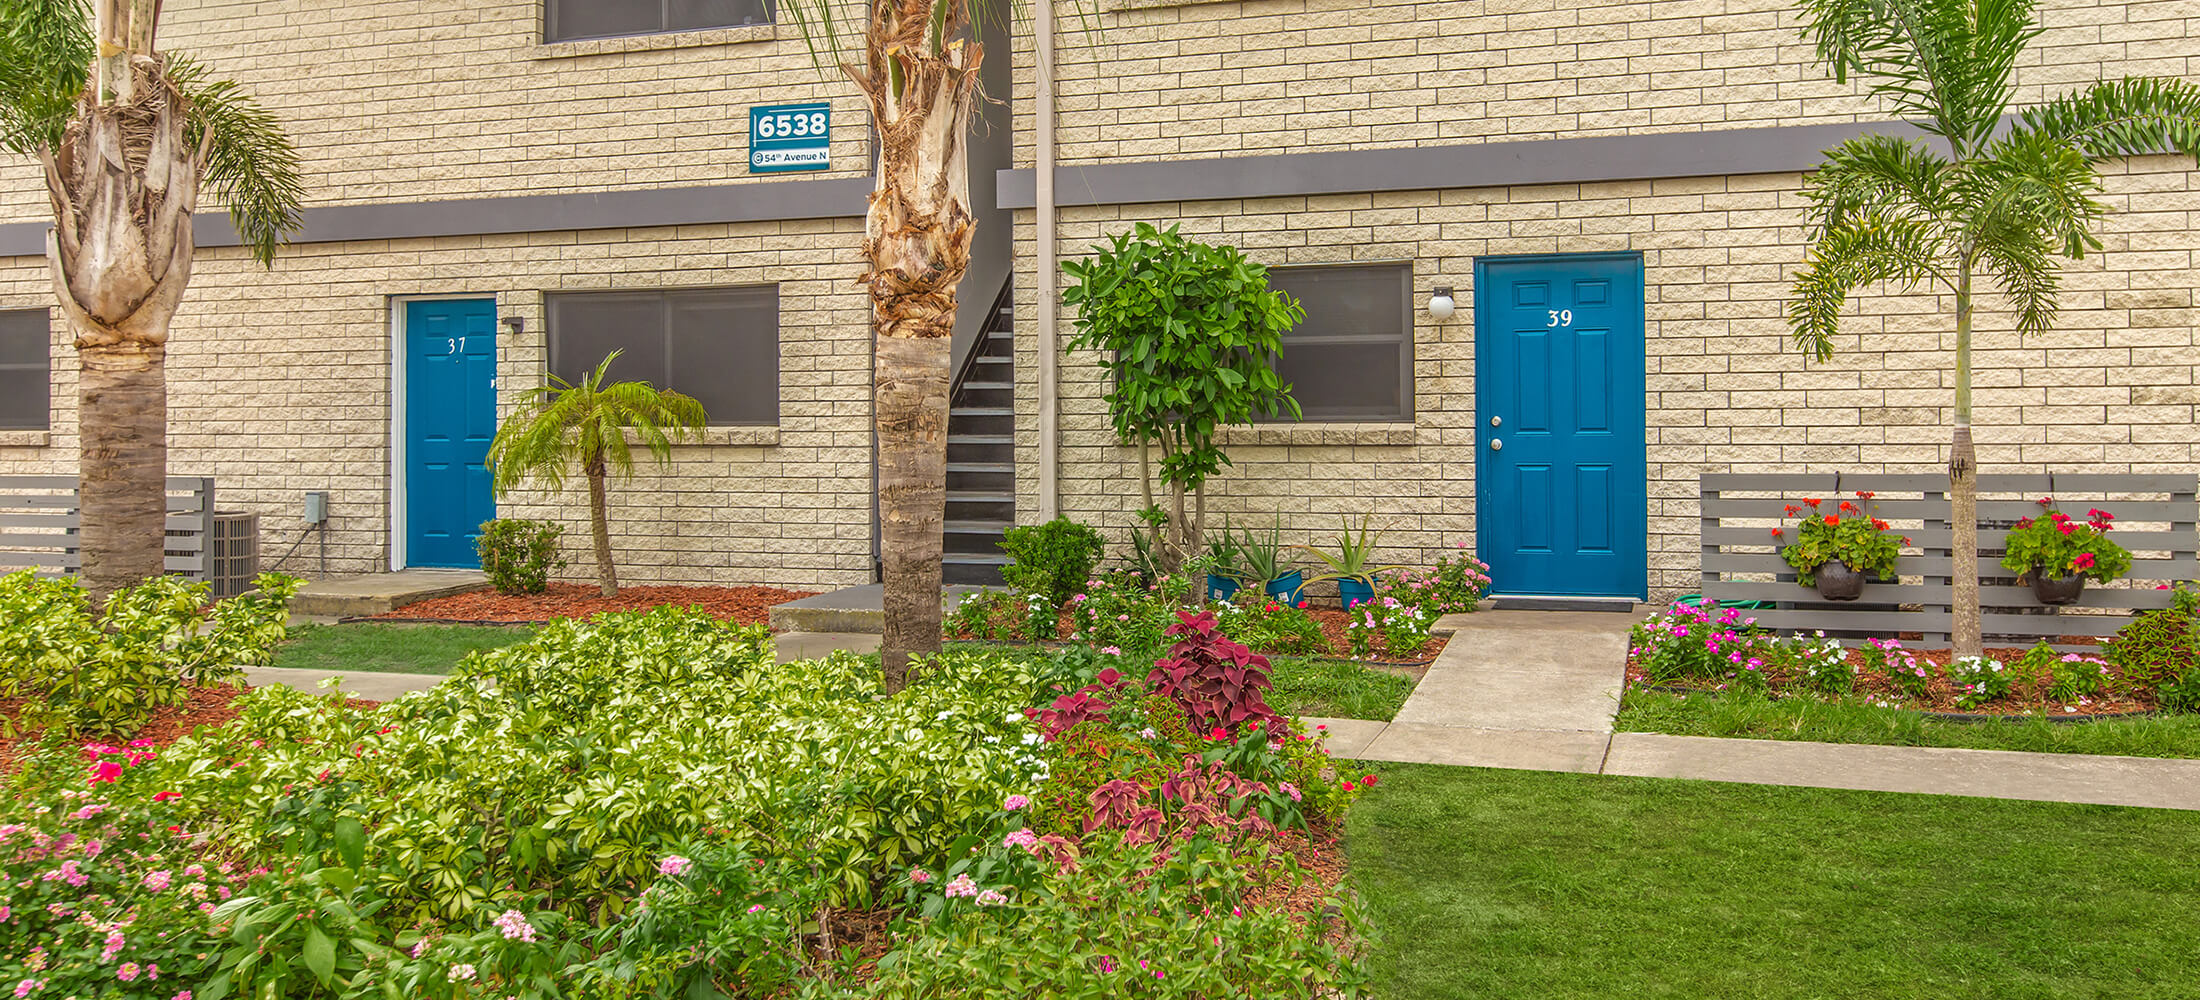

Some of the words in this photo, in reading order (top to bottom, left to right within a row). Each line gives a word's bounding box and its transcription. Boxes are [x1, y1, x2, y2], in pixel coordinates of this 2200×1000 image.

[758, 113, 826, 138] 6538
[764, 153, 782, 162] 54th
[783, 153, 817, 162] Avenue
[819, 151, 826, 160] N
[1546, 309, 1572, 327] 39
[447, 336, 466, 355] 37
